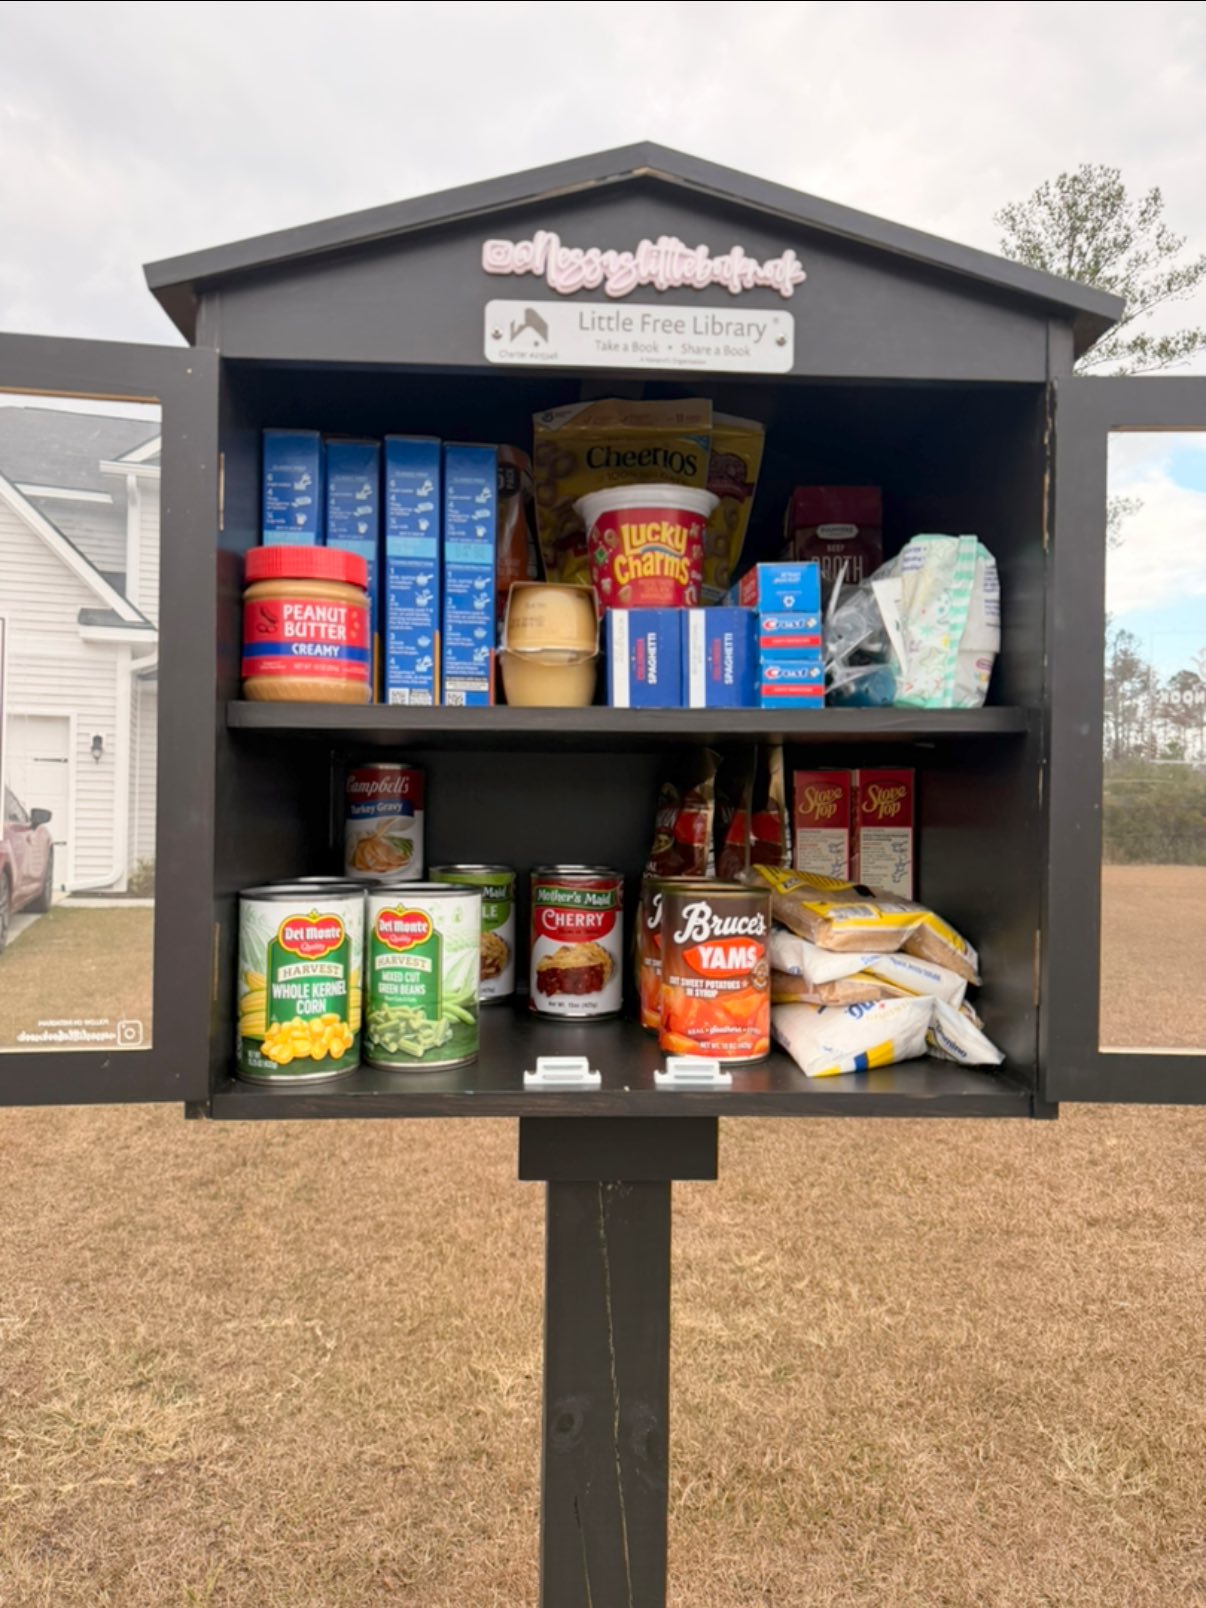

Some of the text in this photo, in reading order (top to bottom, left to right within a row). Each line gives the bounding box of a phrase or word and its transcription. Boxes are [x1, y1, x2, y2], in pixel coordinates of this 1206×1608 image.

[578, 311, 767, 344] Little Free Library
[595, 340, 751, 357] Take a Book Share a Book
[586, 446, 697, 477] Cheerios
[620, 521, 688, 556] Lucky
[613, 551, 690, 586] Charms
[283, 604, 348, 623] PEANUT
[284, 621, 346, 640] BUTTER
[291, 643, 341, 658] CREAMY
[647, 632, 657, 684] SPAGHETTI
[724, 632, 734, 684] SPAGHETTI
[345, 775, 410, 797] Campbell's
[799, 785, 844, 815] Stove
[862, 783, 908, 813] Stove
[351, 802, 403, 815] Turkey Gravy
[815, 803, 838, 821] Top
[878, 801, 902, 820] Top
[584, 891, 611, 906] Maid
[379, 920, 429, 933] Del Monte
[673, 900, 766, 944] Bruce's
[284, 926, 341, 940] Del Monte
[377, 955, 427, 969] HARVEST
[697, 945, 758, 970] YAMS
[283, 964, 340, 978] HARVEST
[404, 972, 421, 983] CUT
[272, 980, 347, 999] WHOLE KERNEL
[378, 983, 427, 996] GREEN BEANS
[682, 977, 704, 988] SWEET
[705, 979, 742, 990] POTATOES
[296, 999, 327, 1015] CORN
